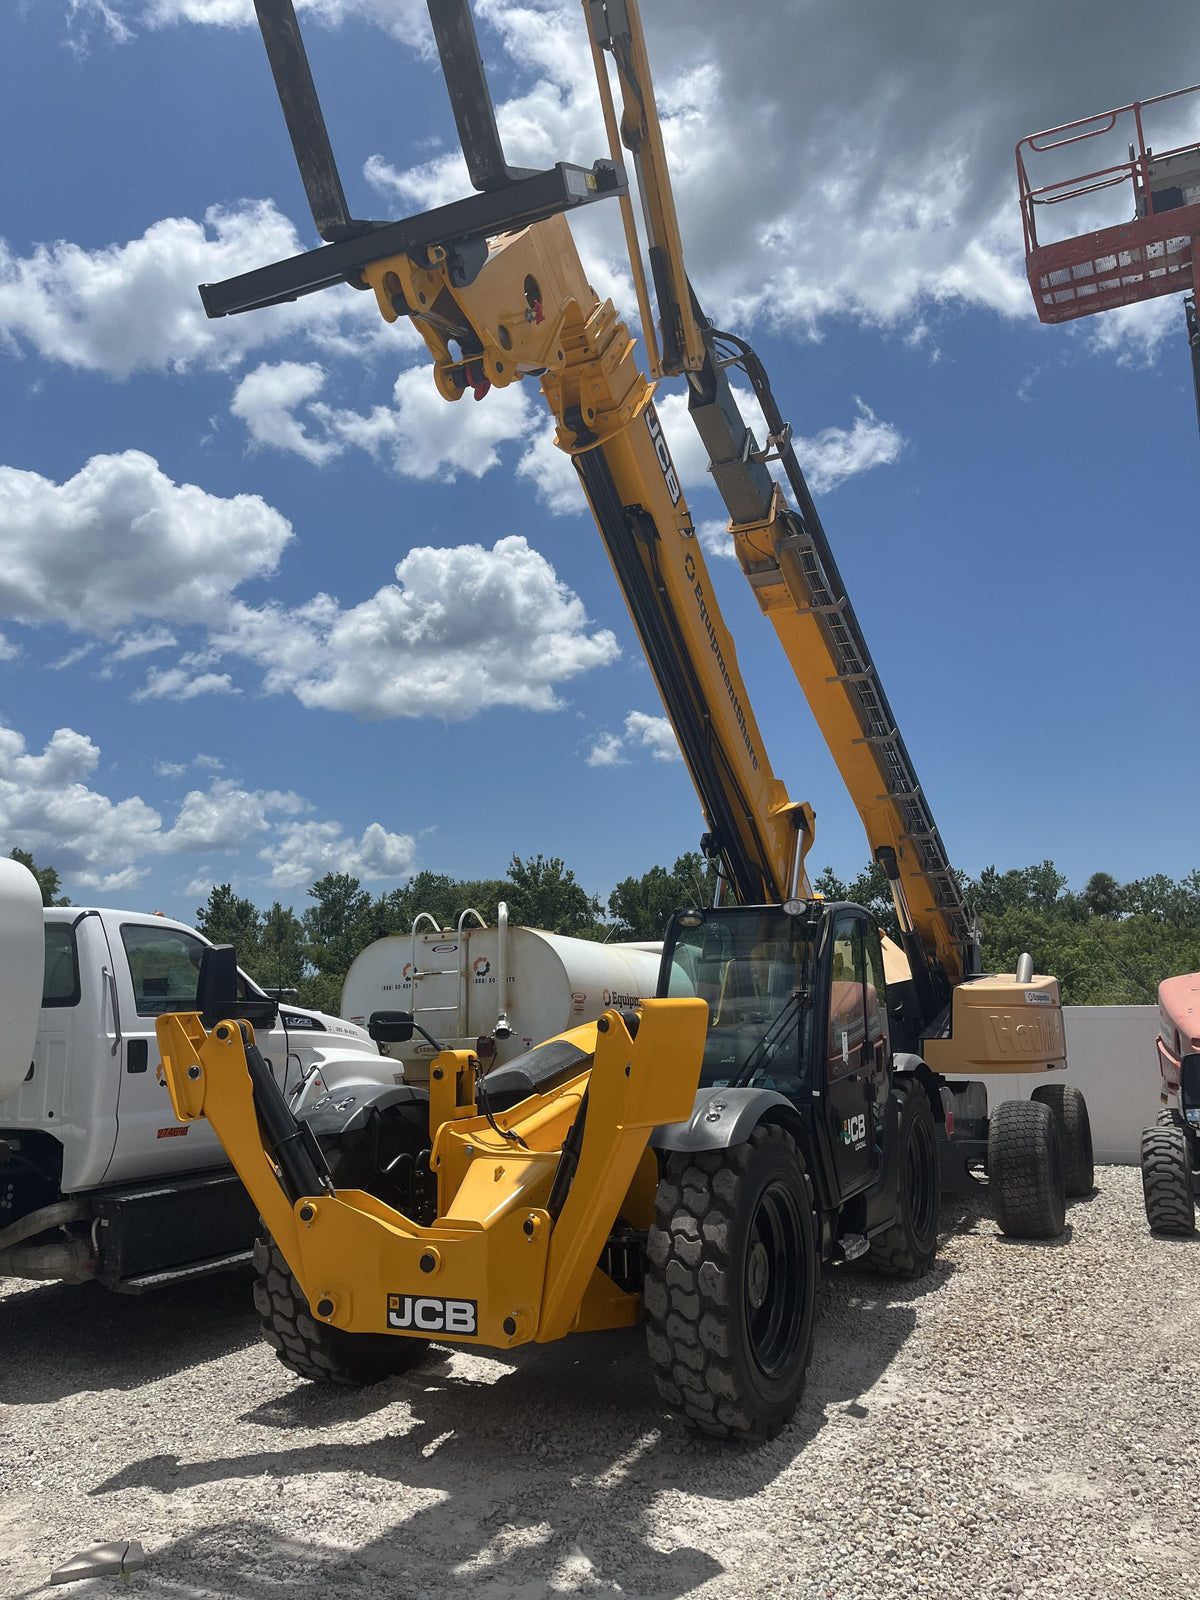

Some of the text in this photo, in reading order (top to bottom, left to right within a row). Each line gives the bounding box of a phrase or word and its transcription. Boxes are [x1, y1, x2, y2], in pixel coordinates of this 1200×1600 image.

[645, 407, 681, 504] JCB
[693, 581, 758, 771] EquipmentShare
[844, 1113, 866, 1145] JCB
[389, 1297, 475, 1333] JCB
